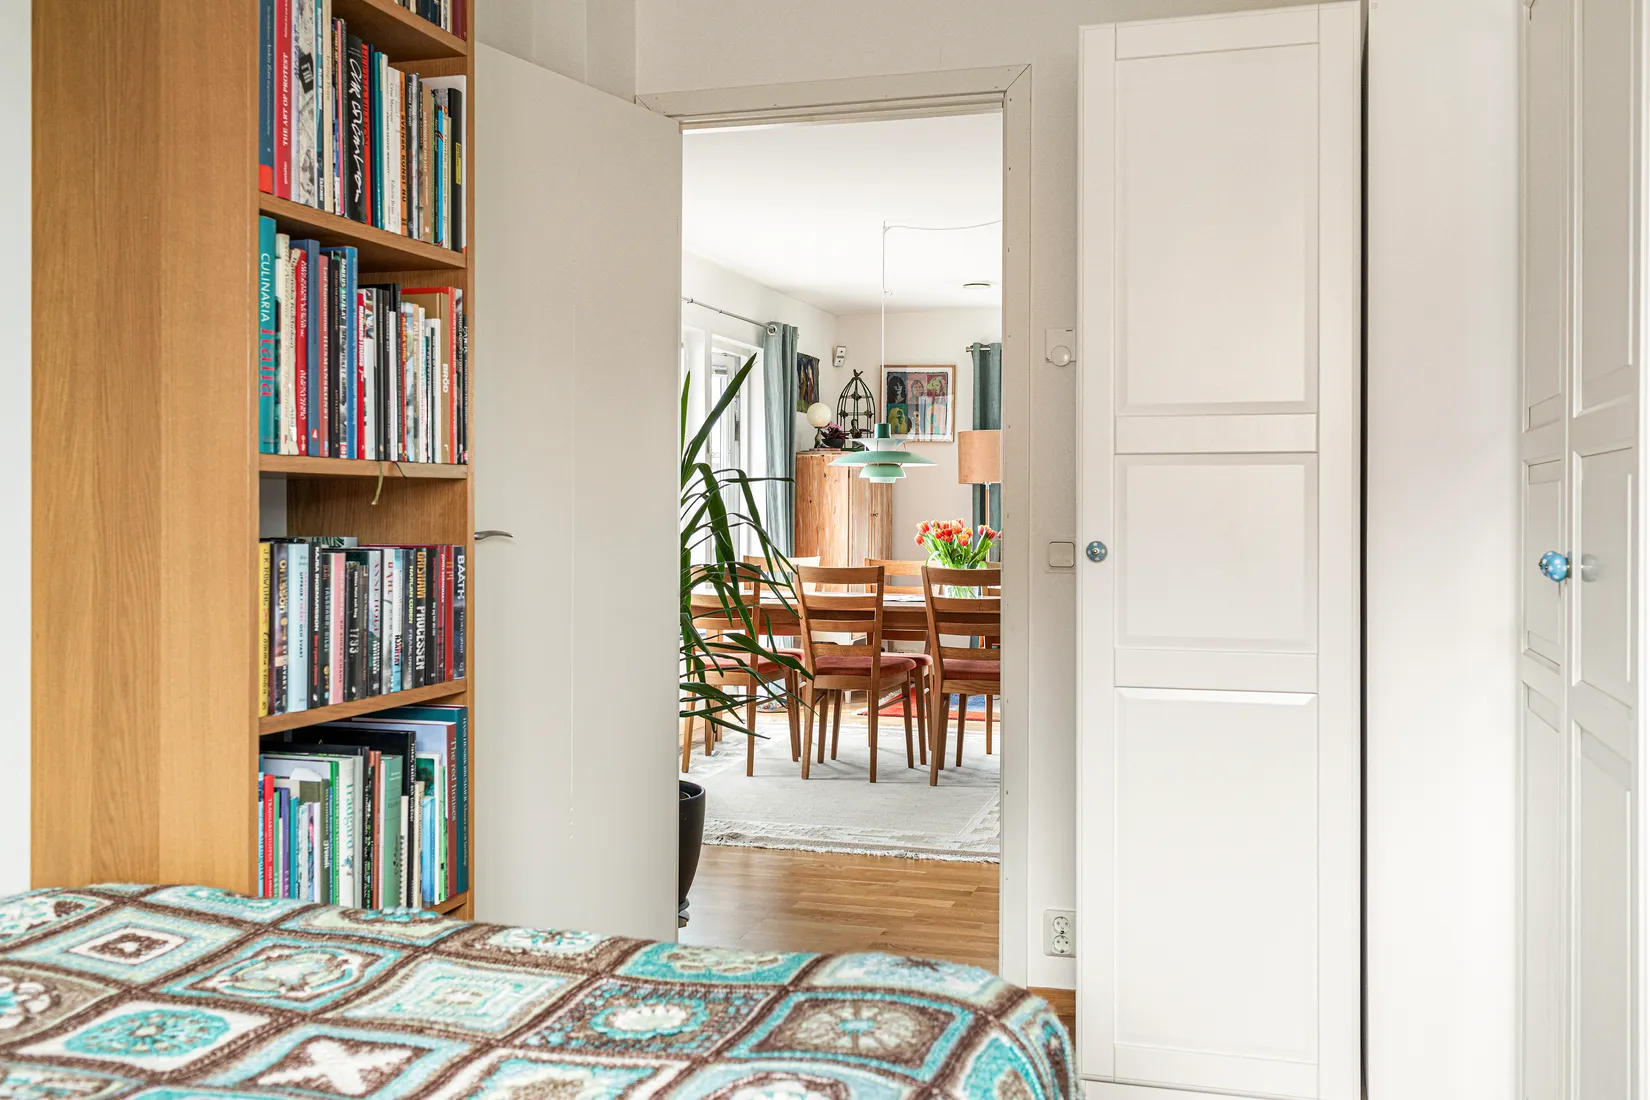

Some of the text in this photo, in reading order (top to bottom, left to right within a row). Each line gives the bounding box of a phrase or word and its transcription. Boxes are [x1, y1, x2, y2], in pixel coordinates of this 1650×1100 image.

[282, 94, 288, 107] OF
[259, 253, 276, 398] CULINARIA Italia
[442, 363, 451, 394] BRÖD
[457, 554, 466, 600] BÅÅTH
[415, 551, 427, 671] GRISHAM PROCESSEN
[348, 627, 360, 654] 1793
